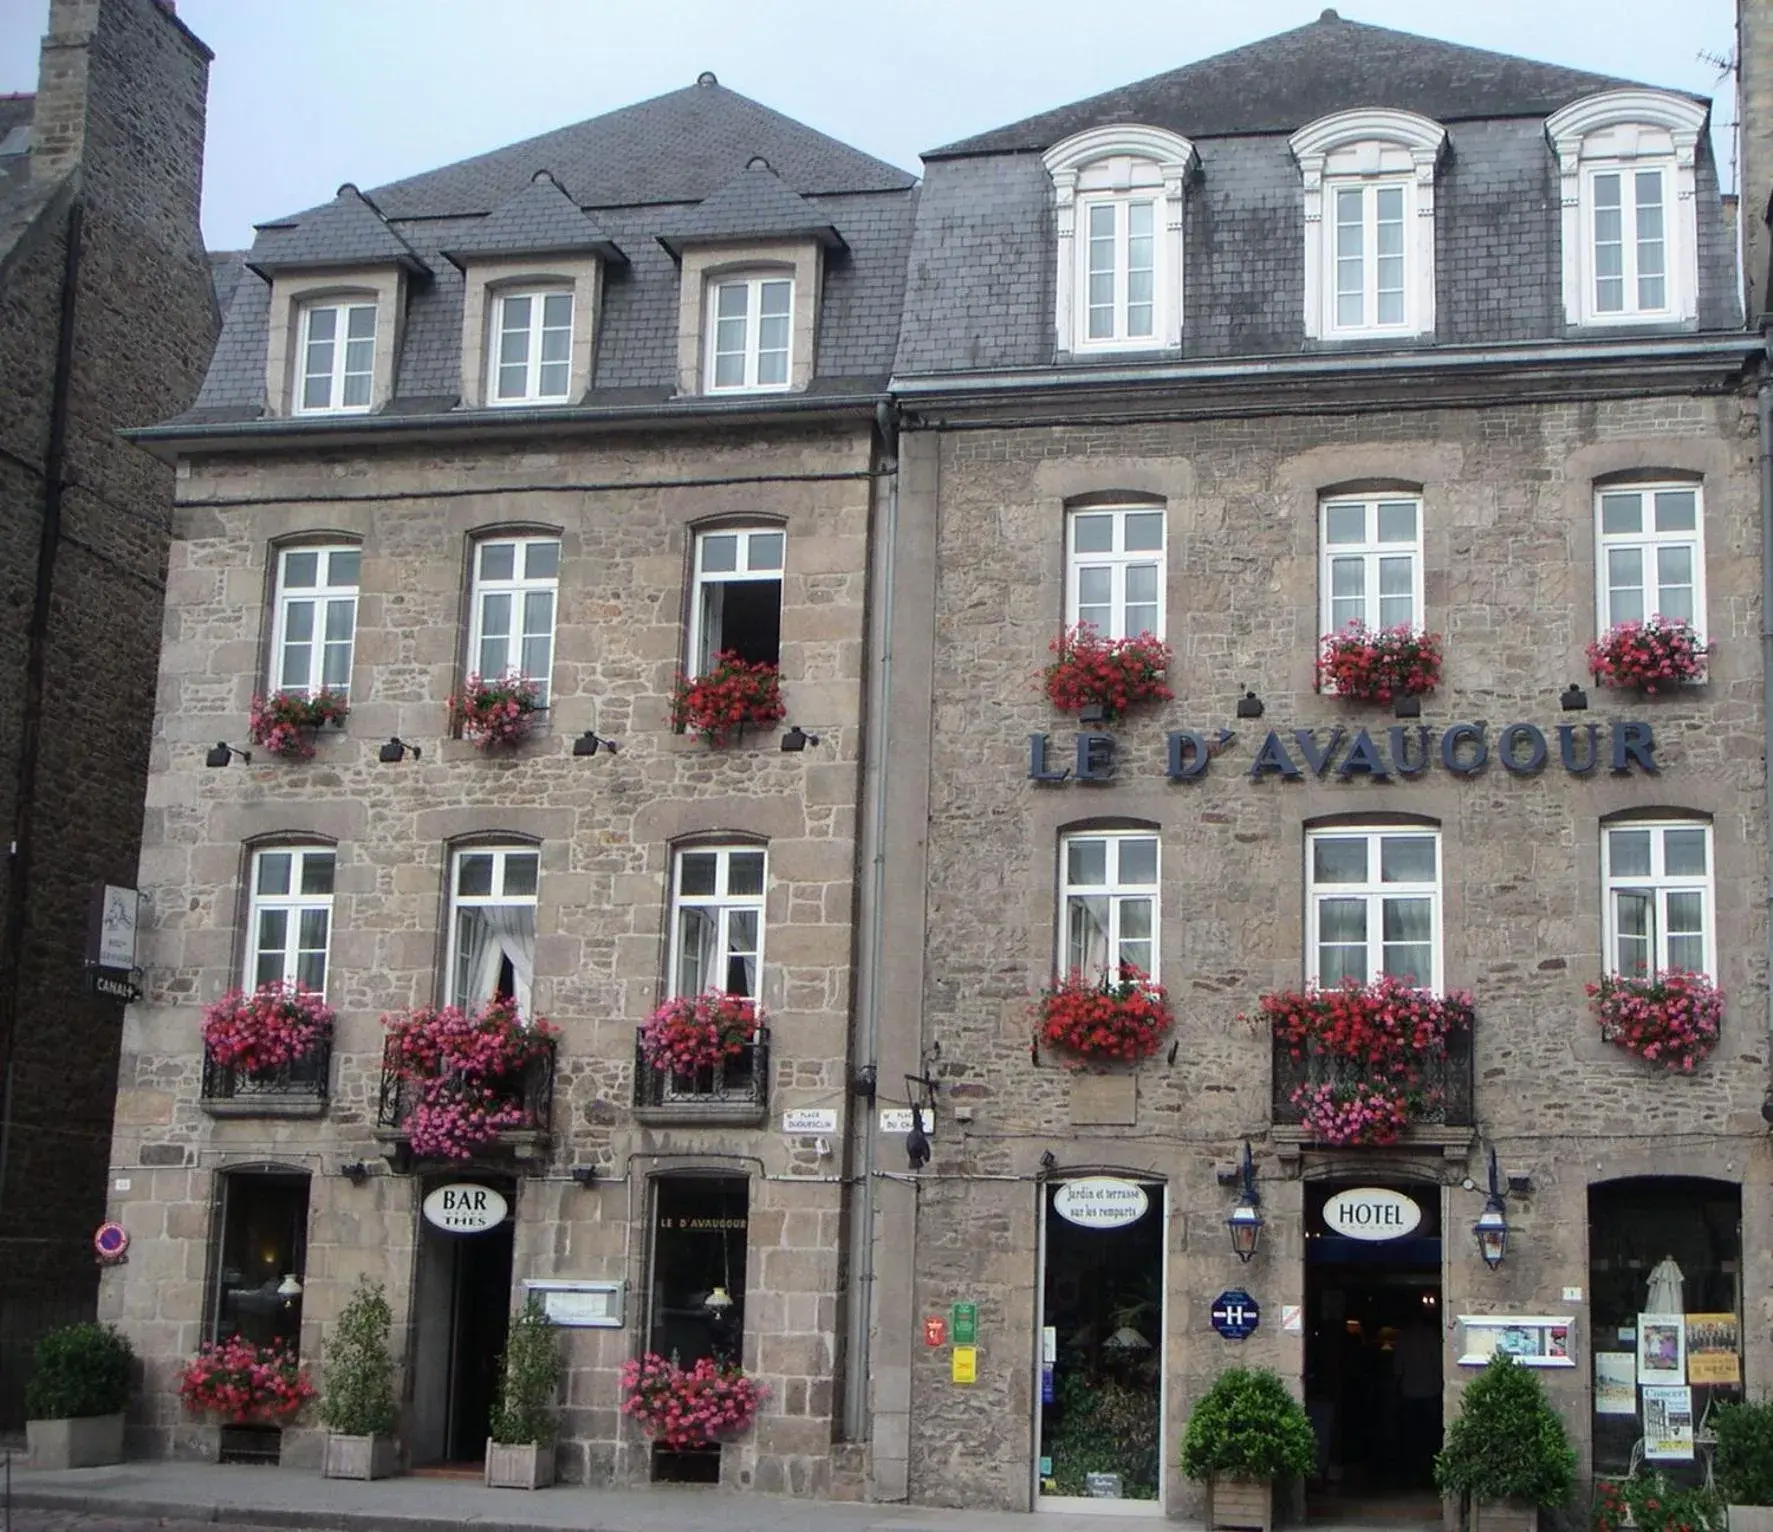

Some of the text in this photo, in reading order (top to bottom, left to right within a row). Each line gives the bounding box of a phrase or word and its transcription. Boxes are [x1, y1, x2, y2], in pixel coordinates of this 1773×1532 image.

[1027, 730, 1117, 781] LE
[443, 1190, 487, 1210] BAR
[661, 1218, 673, 1228] LE
